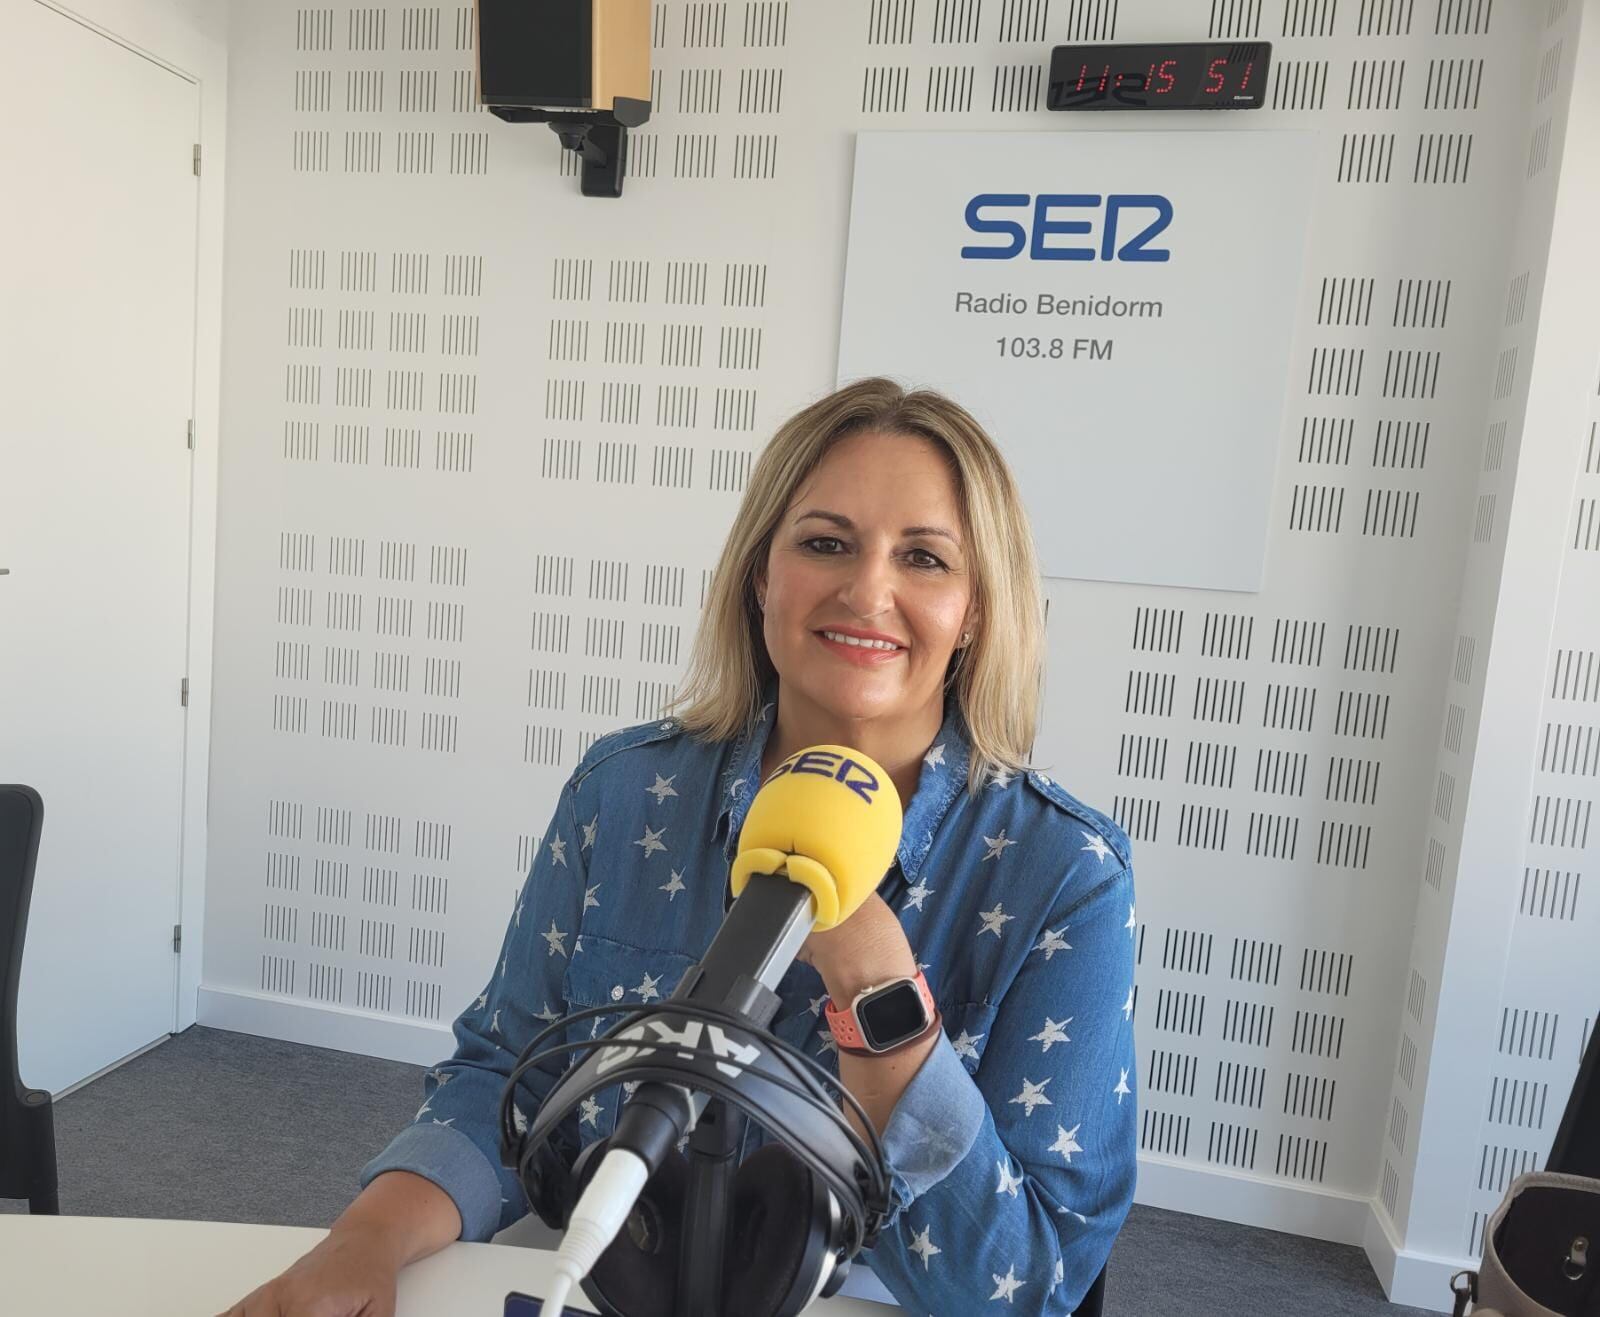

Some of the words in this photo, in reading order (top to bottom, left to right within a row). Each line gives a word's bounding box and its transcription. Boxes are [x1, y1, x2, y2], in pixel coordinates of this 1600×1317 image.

[1205, 60, 1253, 93] 51
[961, 193, 1174, 262] SER
[955, 292, 1028, 315] Radio
[1036, 294, 1163, 317] Benidorm
[996, 337, 1064, 359] 103.8
[1072, 339, 1113, 360] FM
[596, 1020, 761, 1079] AKG
